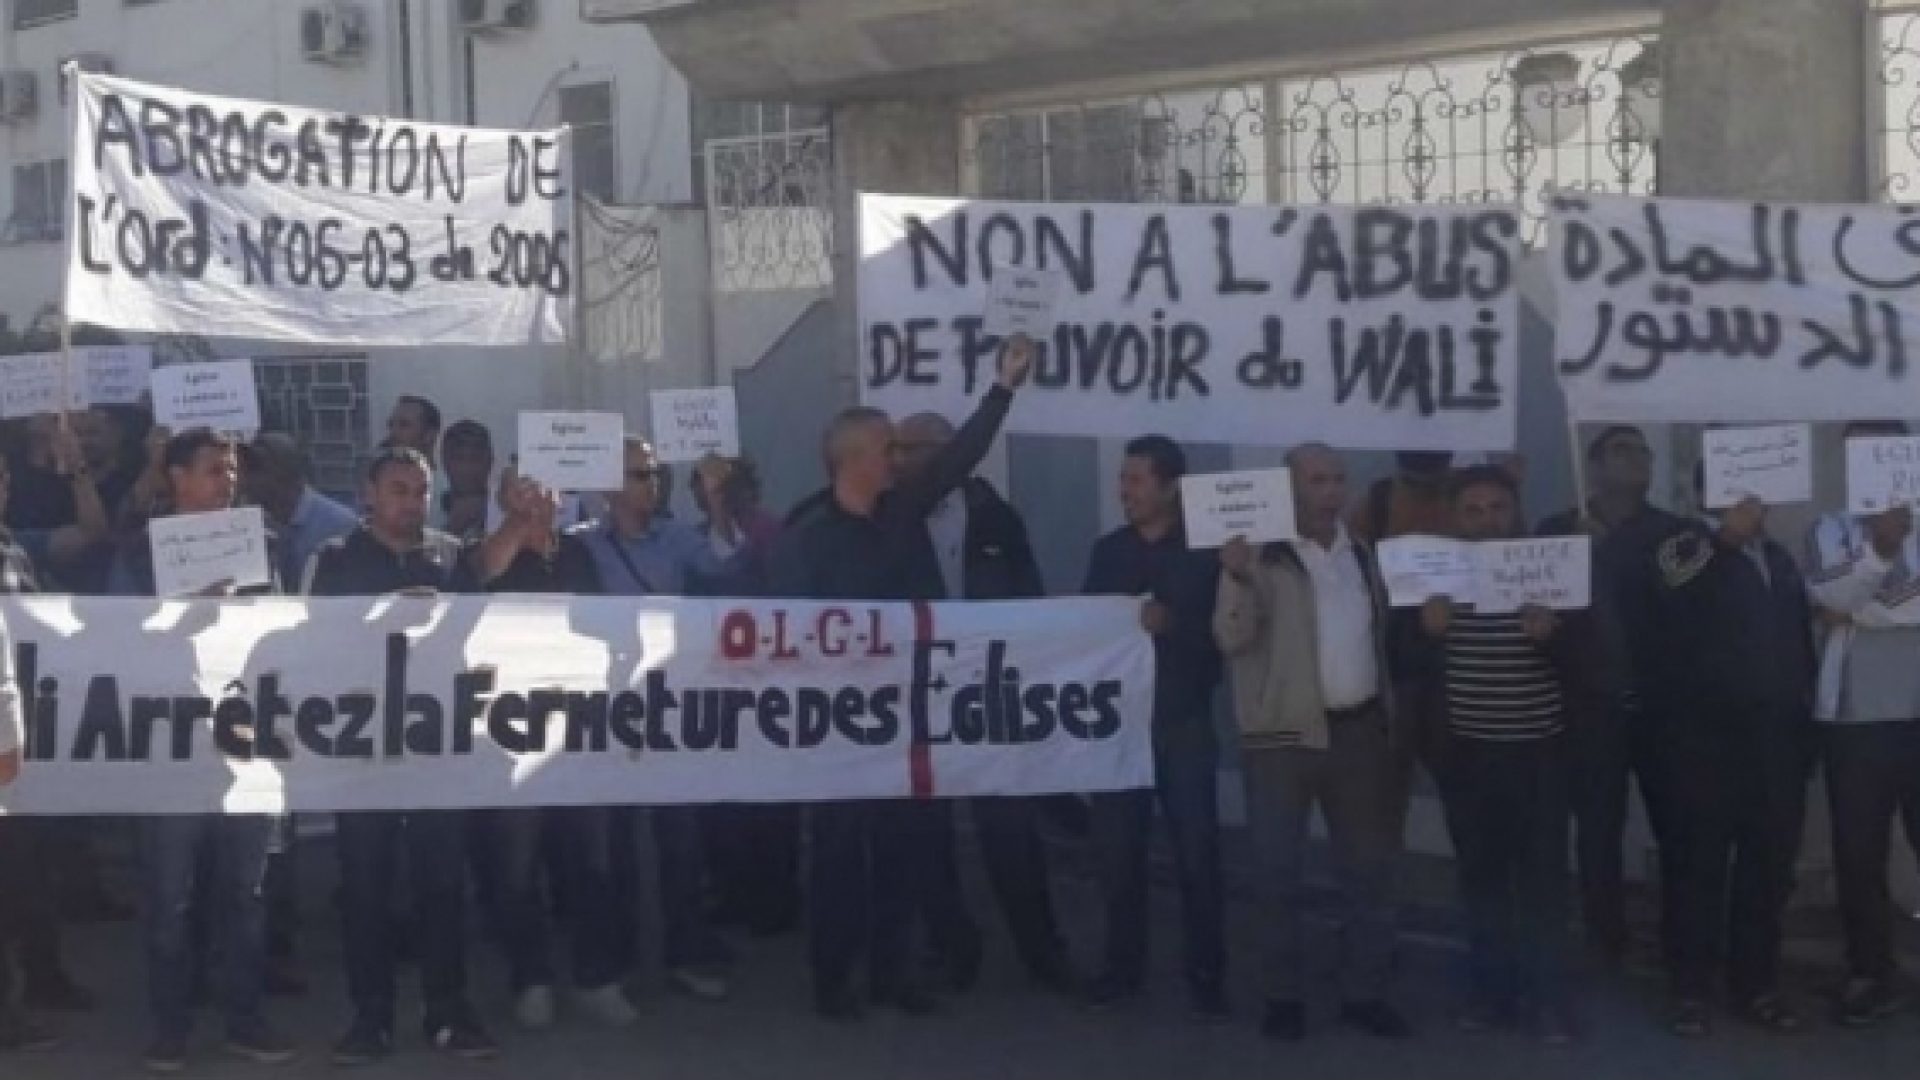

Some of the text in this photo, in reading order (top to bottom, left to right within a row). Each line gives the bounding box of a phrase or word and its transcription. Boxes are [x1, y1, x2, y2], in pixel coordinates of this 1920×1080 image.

[505, 134, 563, 206] DE
[488, 223, 570, 296] 2006
[903, 209, 1095, 294] NON
[1125, 213, 1181, 300] A
[868, 315, 941, 389] DE
[1236, 315, 1304, 389] du
[70, 672, 374, 763] Arrêtez
